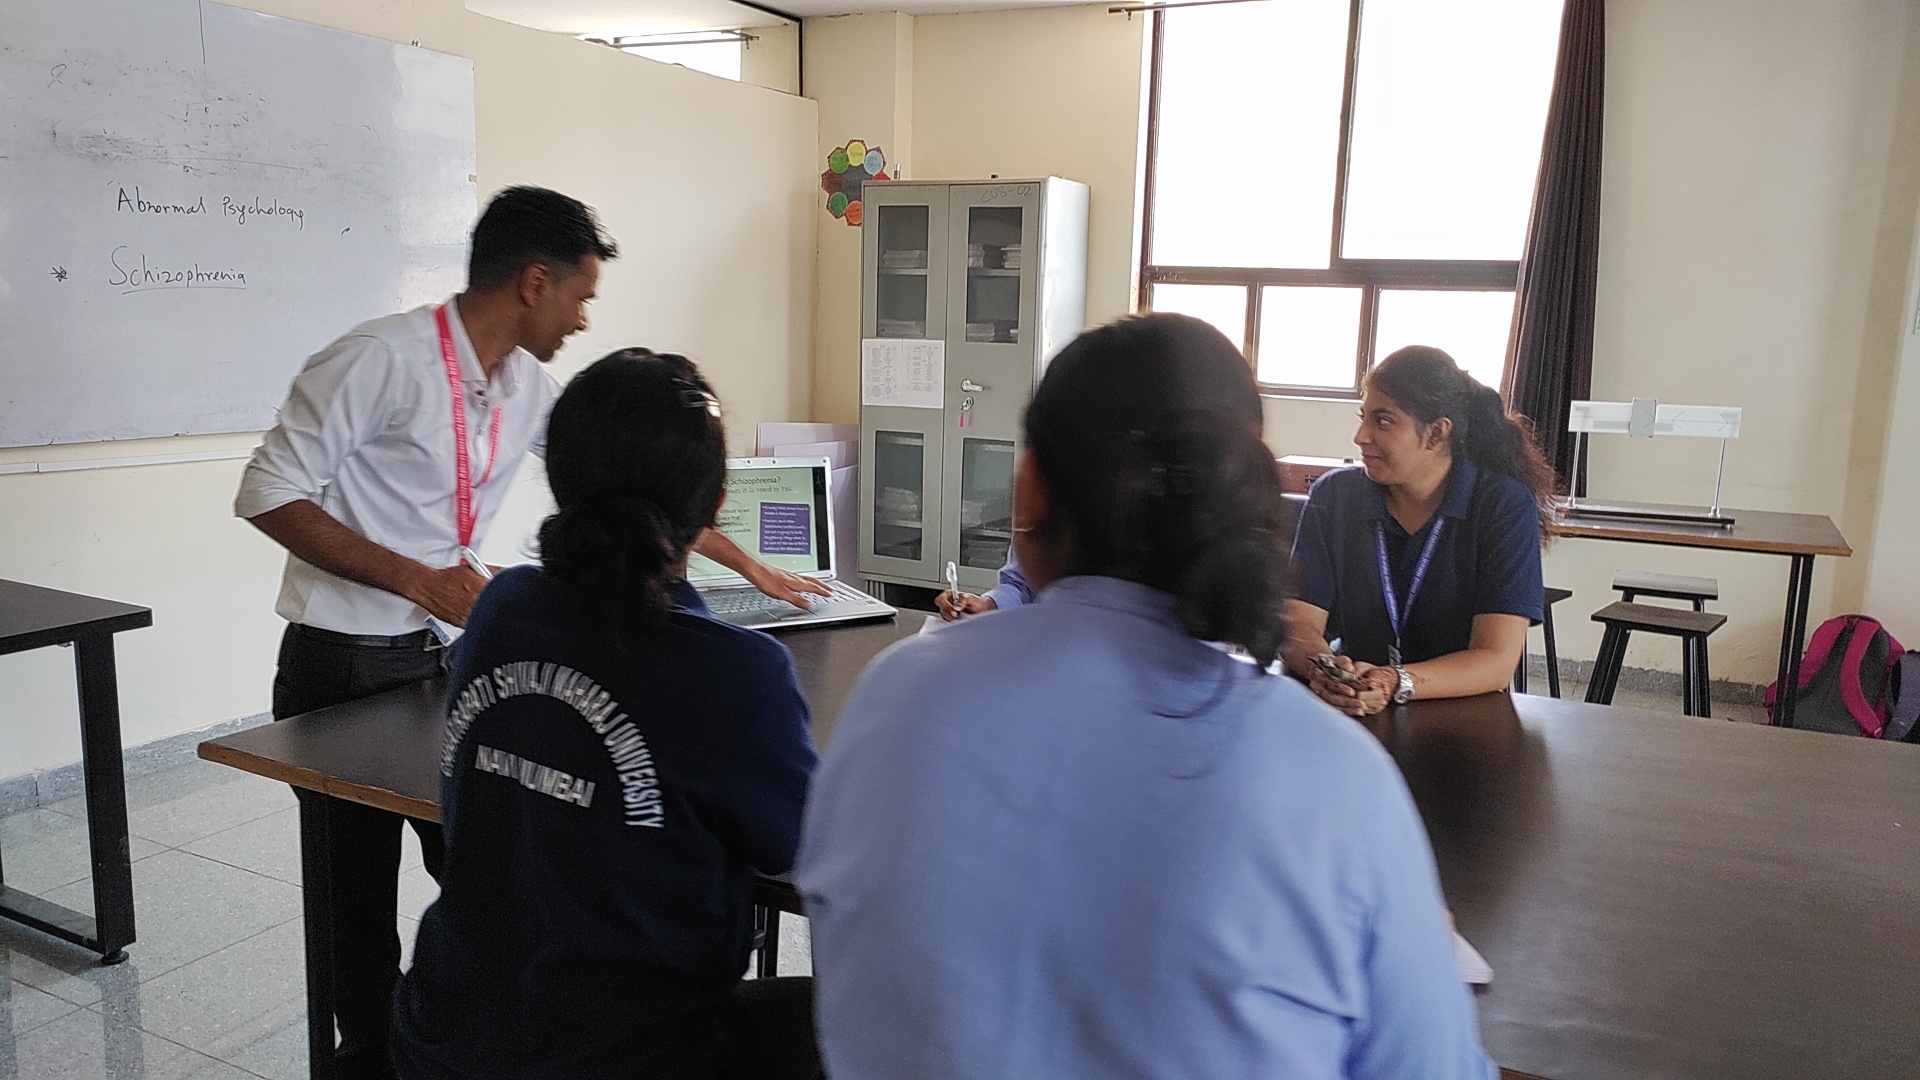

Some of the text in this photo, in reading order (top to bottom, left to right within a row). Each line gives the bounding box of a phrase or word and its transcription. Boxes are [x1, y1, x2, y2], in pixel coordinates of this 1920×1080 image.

[117, 186, 304, 231] Abnormal Psychology
[109, 245, 247, 288] Schizophrenia
[603, 721, 665, 829] UNIVERSITY
